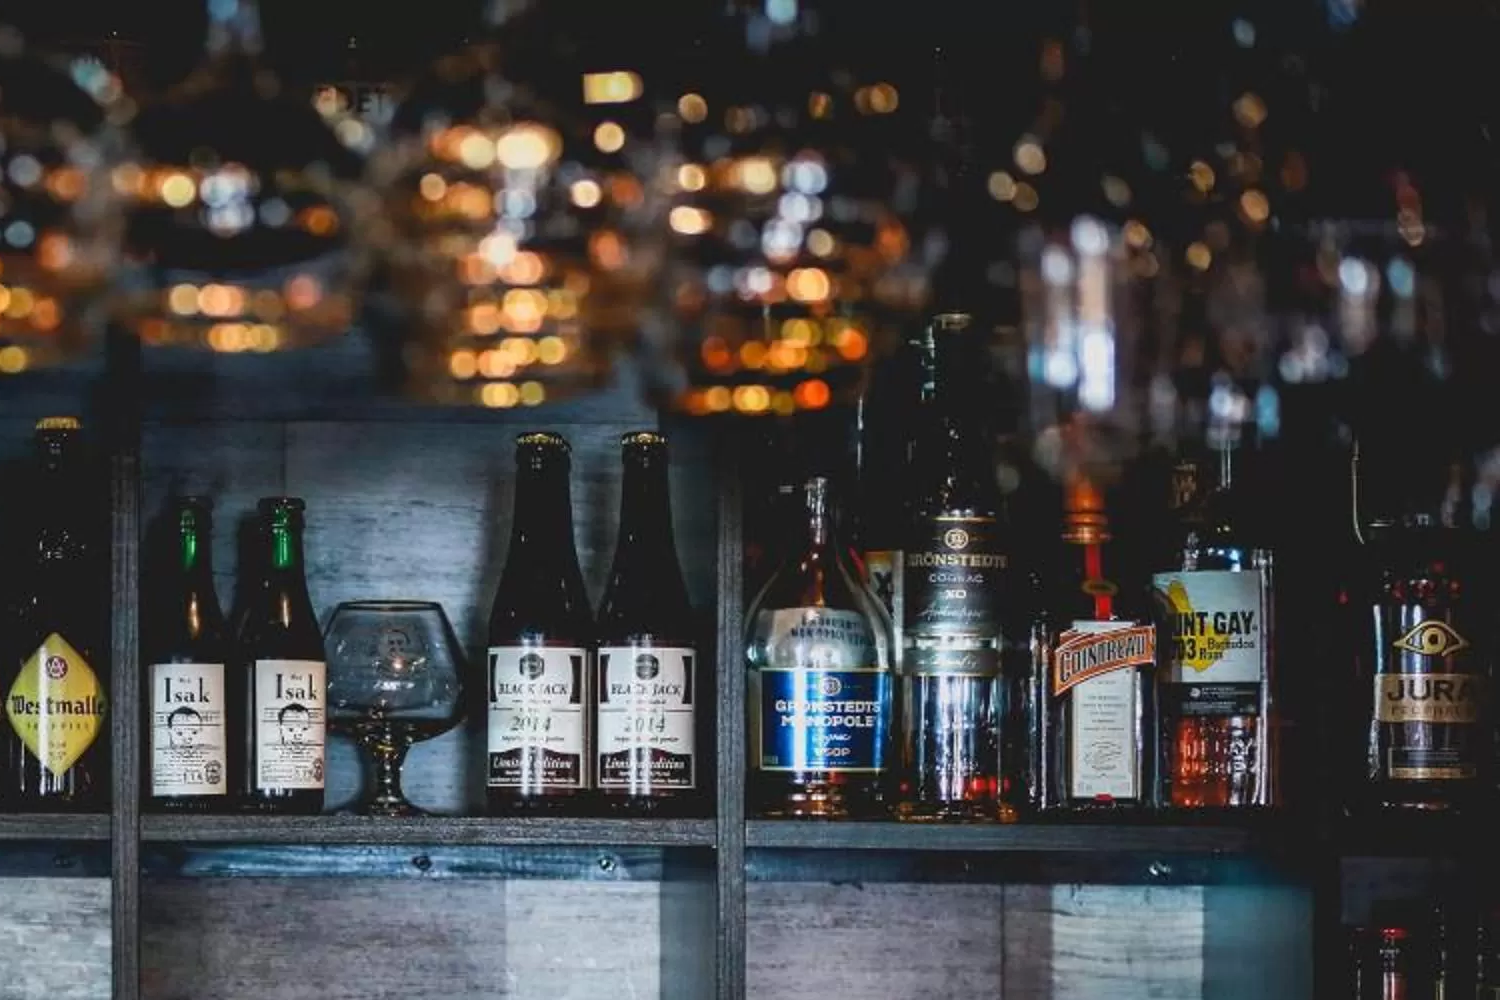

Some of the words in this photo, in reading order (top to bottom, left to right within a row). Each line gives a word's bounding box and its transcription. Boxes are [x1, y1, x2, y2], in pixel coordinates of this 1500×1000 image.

[1213, 611, 1255, 635] GAY
[1060, 633, 1146, 682] COINTREAU
[164, 677, 211, 703] Isak
[275, 673, 318, 701] Isak
[539, 683, 568, 695] ACK
[780, 715, 874, 728] MNOPOLE
